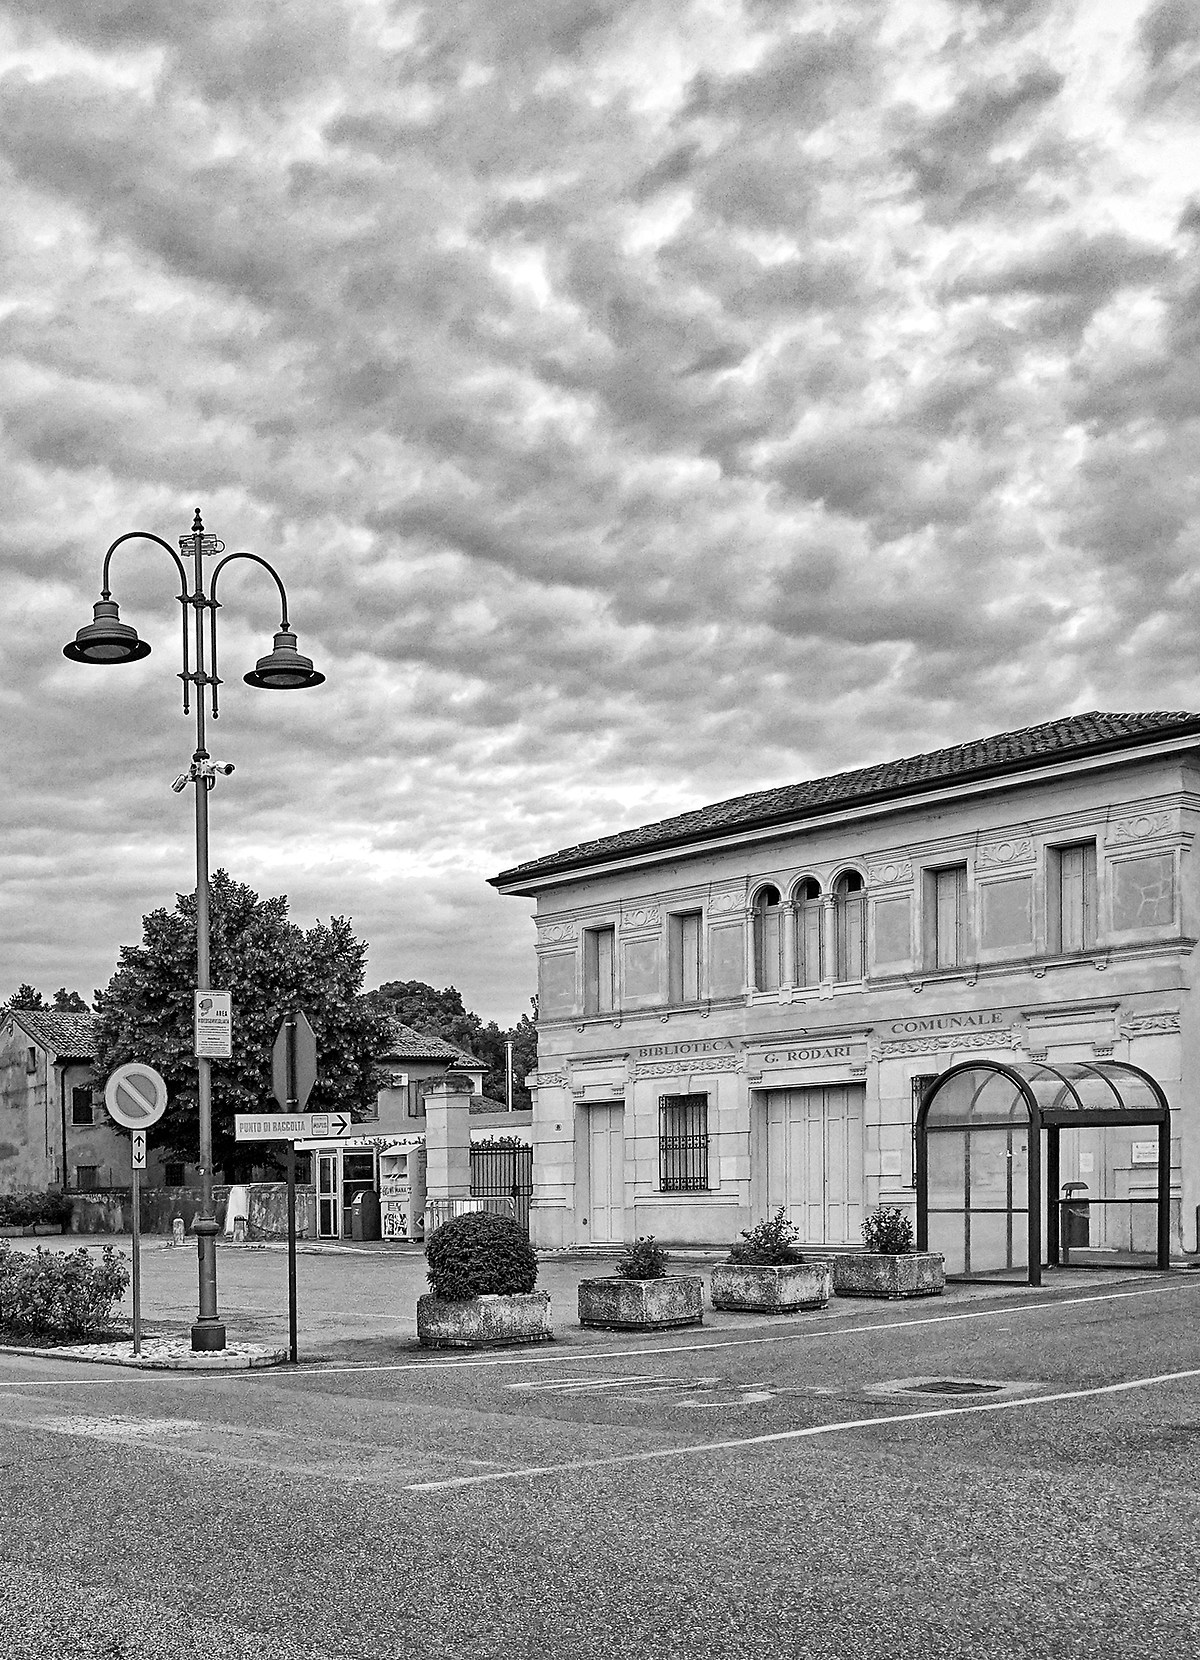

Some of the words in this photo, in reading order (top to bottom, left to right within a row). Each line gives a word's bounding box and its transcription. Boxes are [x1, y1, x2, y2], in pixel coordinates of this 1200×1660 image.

[891, 1012, 1003, 1034] COMUNALE
[639, 1040, 735, 1058] BIBLIOTECA
[764, 1053, 779, 1064] G.
[787, 1046, 851, 1061] RODARI
[239, 1121, 261, 1133] PUNTO
[263, 1121, 271, 1133] DI
[272, 1120, 306, 1132] RACCOLTA
